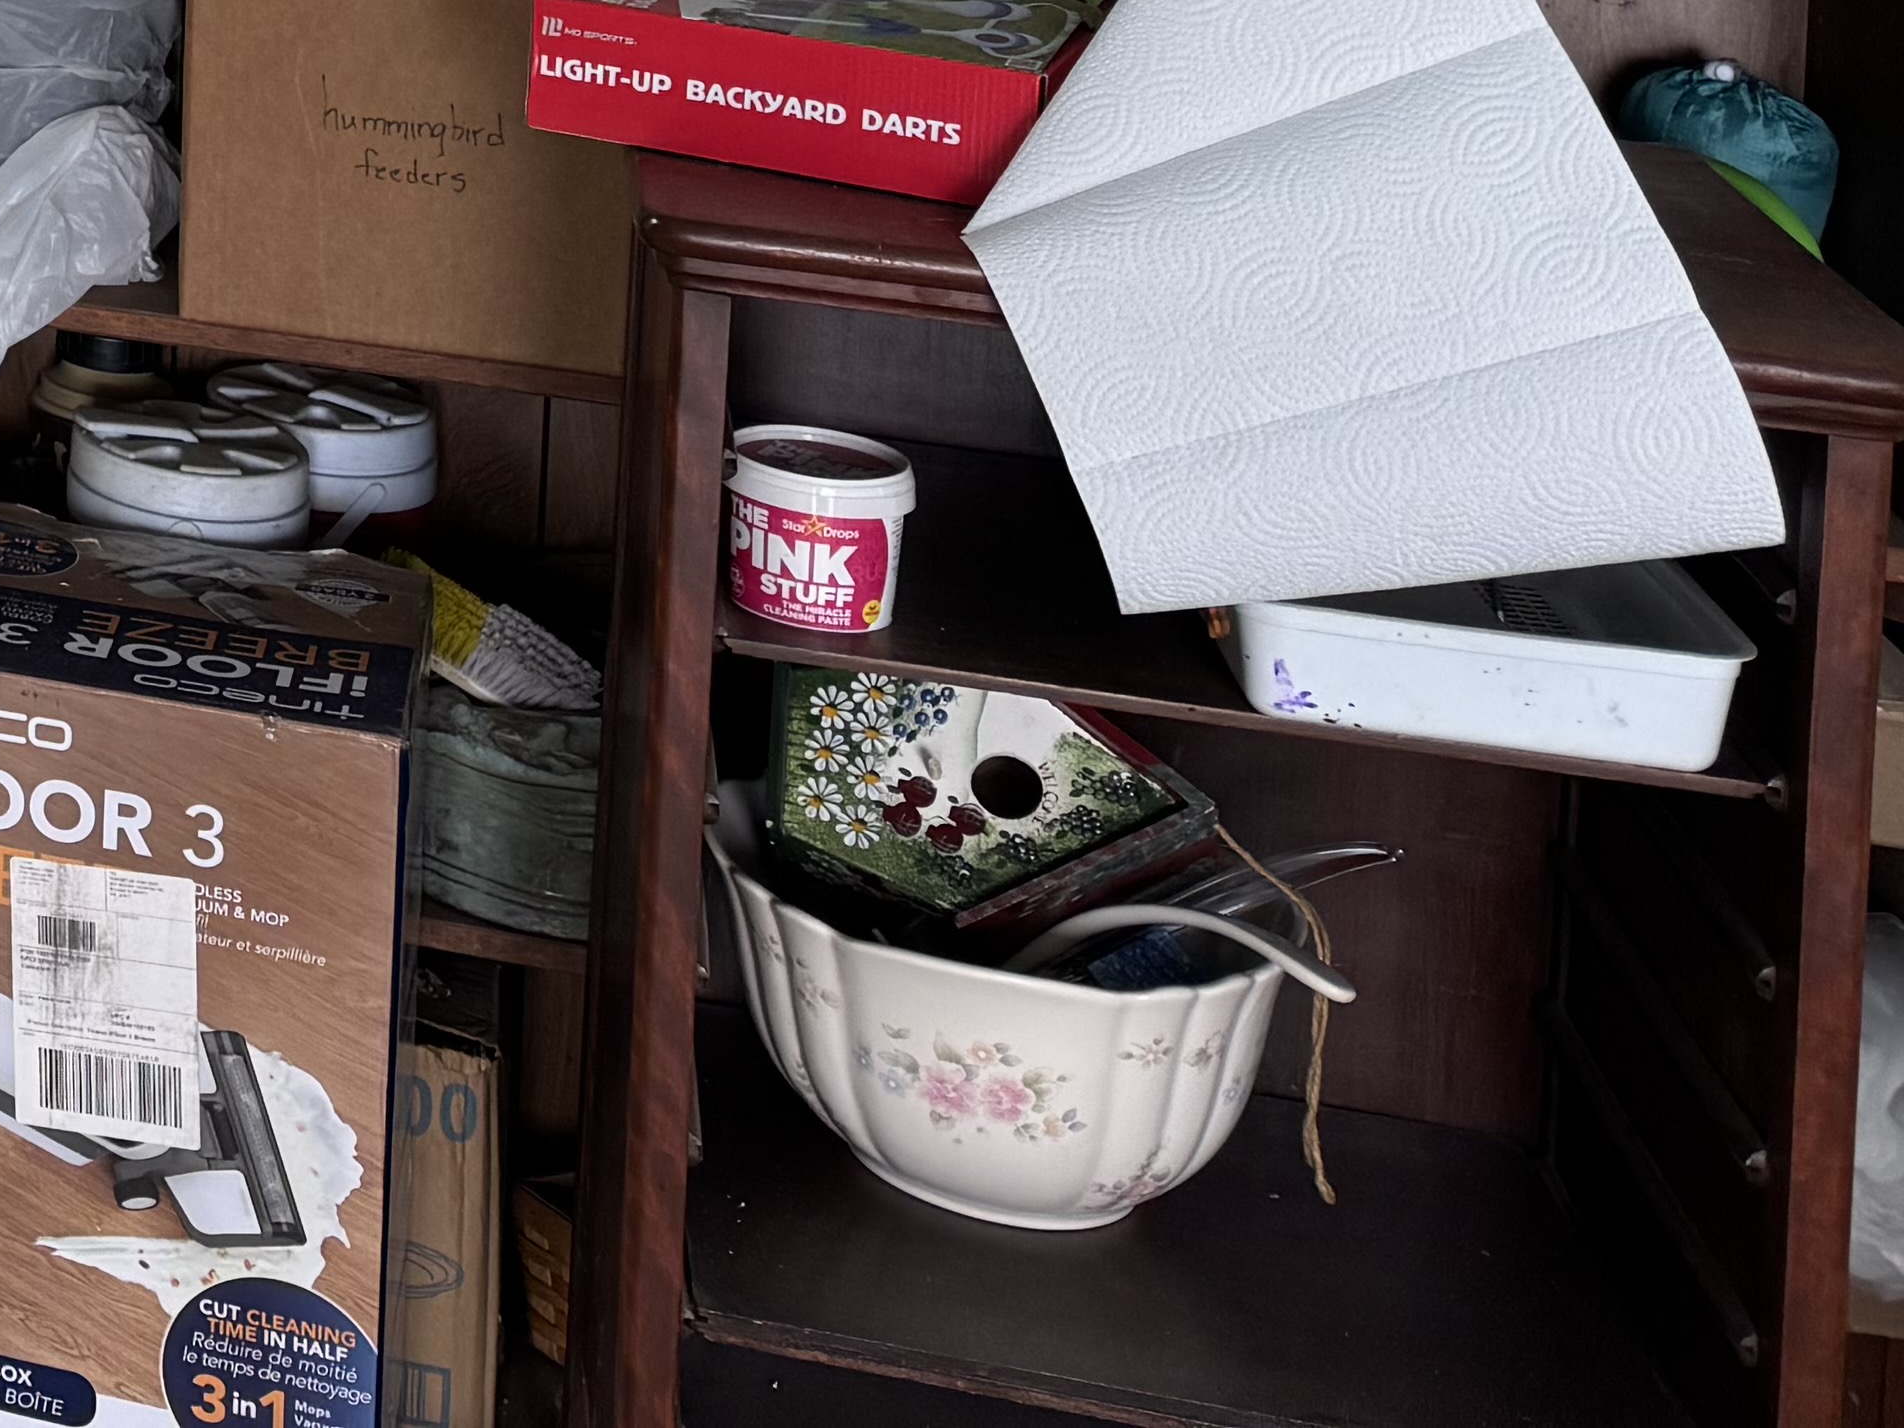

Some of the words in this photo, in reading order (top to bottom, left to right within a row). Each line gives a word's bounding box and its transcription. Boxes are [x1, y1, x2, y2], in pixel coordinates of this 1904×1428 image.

[583, 30, 635, 45] SPORTS
[322, 73, 505, 158] hummingbird
[540, 54, 672, 95] LIGHT-UP
[686, 79, 847, 126] BACKYARD
[861, 108, 962, 145] DARTS
[354, 148, 467, 193] feeders
[732, 494, 770, 530] THE
[823, 527, 860, 540] Drops
[730, 514, 859, 587] PINK
[760, 573, 855, 608] STUFF
[782, 600, 803, 611] THE
[763, 603, 816, 624] CLEANING
[818, 615, 851, 626] PASTE
[82, 609, 369, 672] BREEZE
[64, 631, 369, 699] iFLOOR
[182, 804, 225, 868] 3
[194, 883, 242, 904] DLESS
[234, 907, 245, 919] &
[250, 908, 289, 927] MOP
[236, 941, 250, 952] et
[199, 1298, 240, 1321] CUT
[246, 1309, 356, 1348] CLEANING
[207, 1317, 257, 1343] TIME
[263, 1328, 286, 1350] IN
[293, 1336, 348, 1363] HALF
[183, 1345, 196, 1364] le
[202, 1352, 254, 1379] temps
[258, 1365, 281, 1382] de
[285, 1373, 372, 1406] nettoyage
[192, 1331, 263, 1361] Réduire
[269, 1350, 292, 1368] de
[298, 1359, 358, 1384] moitié
[5, 1383, 64, 1417] BOÎTE
[191, 1373, 227, 1424] 3
[232, 1391, 257, 1419] in
[259, 1390, 287, 1428] 1
[294, 1399, 332, 1419] Mops
